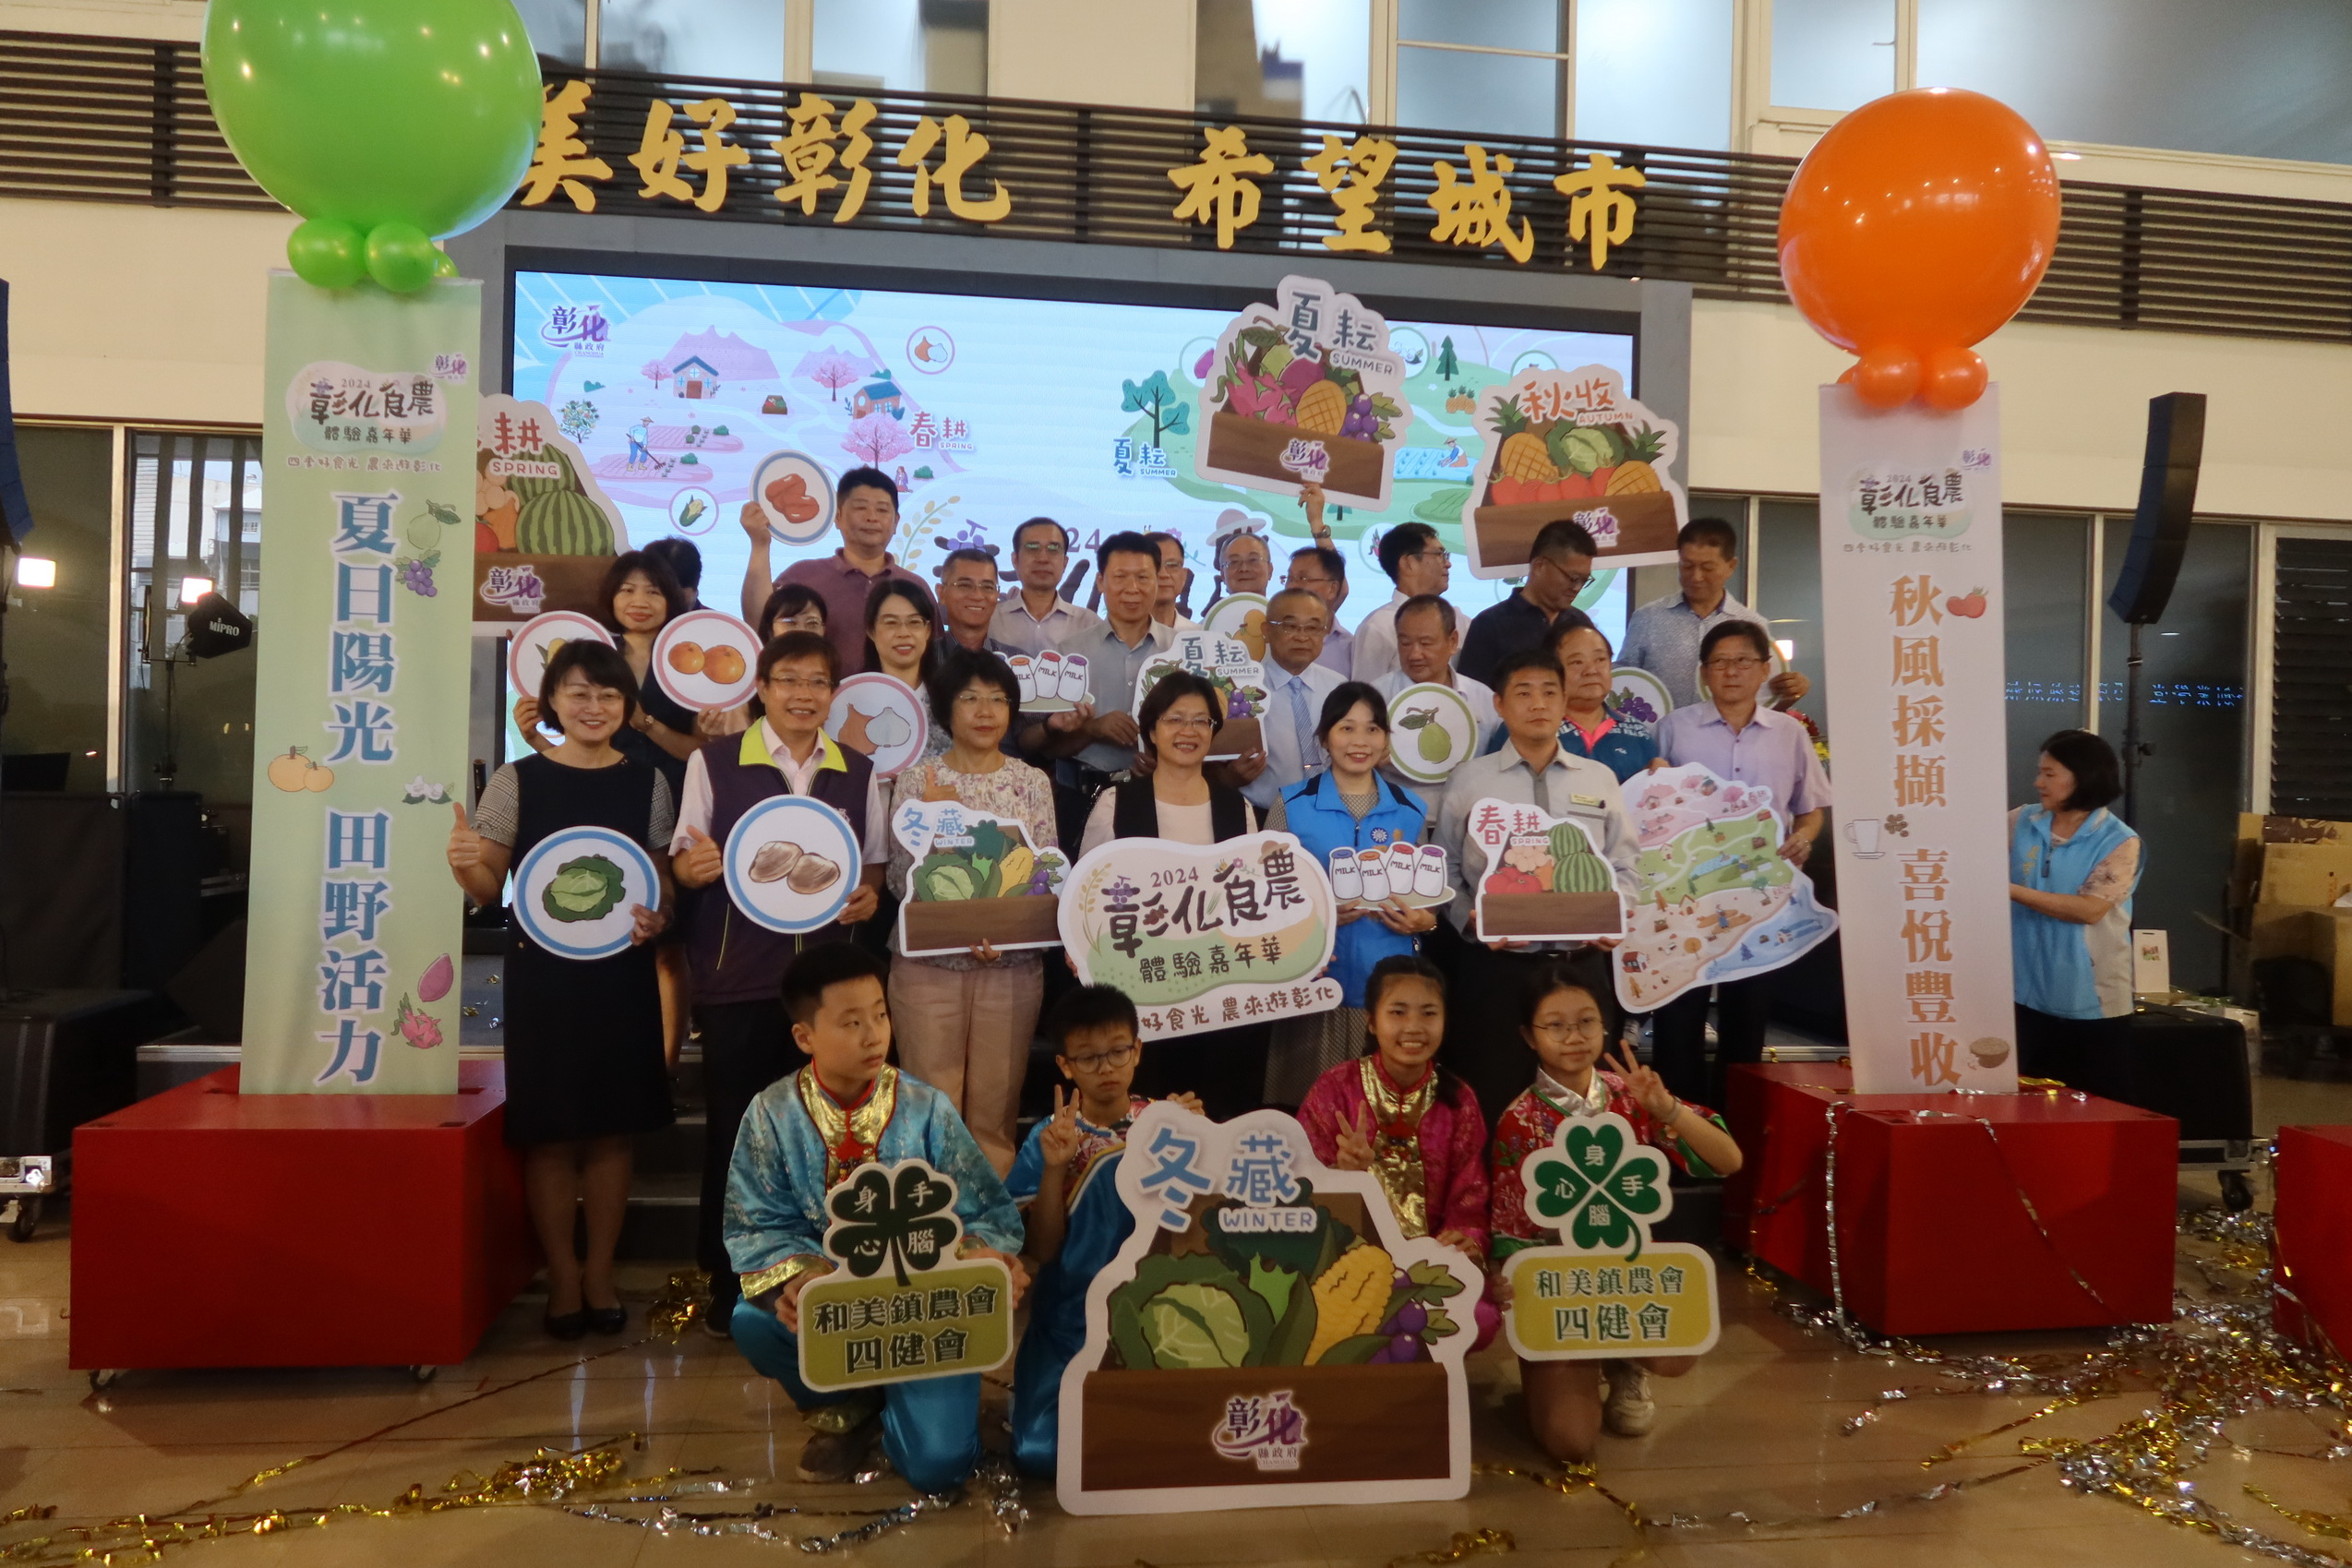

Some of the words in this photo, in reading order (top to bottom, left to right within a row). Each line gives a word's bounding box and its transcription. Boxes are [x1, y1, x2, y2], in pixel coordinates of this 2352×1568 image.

[520, 79, 1012, 223] 美好彰化
[1167, 125, 1646, 270] 希望城市
[551, 305, 606, 341] 彰化
[1288, 292, 1377, 359] 夏耘
[1332, 353, 1393, 376] SUMMER
[1522, 377, 1614, 422] 秋收
[477, 412, 543, 454] 耕
[909, 411, 966, 448] 春耕
[1579, 413, 1633, 424] AUTUMN
[492, 461, 558, 476] SPRING
[1113, 438, 1166, 474] 夏耘
[1140, 468, 1176, 476] SUMMER
[490, 568, 542, 598] 彰化
[327, 493, 399, 762] 夏日陽光
[1038, 666, 1057, 677] MILK
[1182, 637, 1242, 676] 夏耘
[1218, 666, 1259, 676] SUMMER
[1064, 671, 1084, 680] MILK
[1890, 575, 1946, 808] 秋風採擷
[901, 807, 966, 846] 冬藏
[1476, 805, 1540, 844] 春耕
[1150, 866, 1199, 889] 2024
[1335, 867, 1355, 875] MILK
[1362, 868, 1383, 877] MILK
[1390, 860, 1411, 870] MILK
[1420, 863, 1441, 873] MILK
[1101, 849, 1306, 959] 彰化食農
[318, 811, 389, 1083] 田野活力
[1139, 935, 1282, 984] 體驗嘉年華
[1897, 849, 1962, 1087] 喜悅豐收
[1221, 986, 1335, 1023] 農來遊彰化
[1584, 1144, 1606, 1167] 身
[1140, 1127, 1296, 1227] 冬藏
[1554, 1178, 1577, 1199] 心
[1622, 1174, 1644, 1197] 手
[853, 1185, 878, 1214] 身
[907, 1180, 933, 1208] 手
[1222, 1211, 1313, 1228] WINTER
[1588, 1204, 1610, 1227] 腦
[853, 1239, 882, 1256] 心
[906, 1228, 934, 1255] 腦
[1535, 1265, 1685, 1299] 和美鎮農會
[813, 1284, 998, 1335] 和美鎮農會
[1554, 1302, 1671, 1341] 四健會
[846, 1326, 968, 1375] 四健會
[1228, 1397, 1299, 1445] 彰化
[1257, 1446, 1297, 1458] 縣政府
